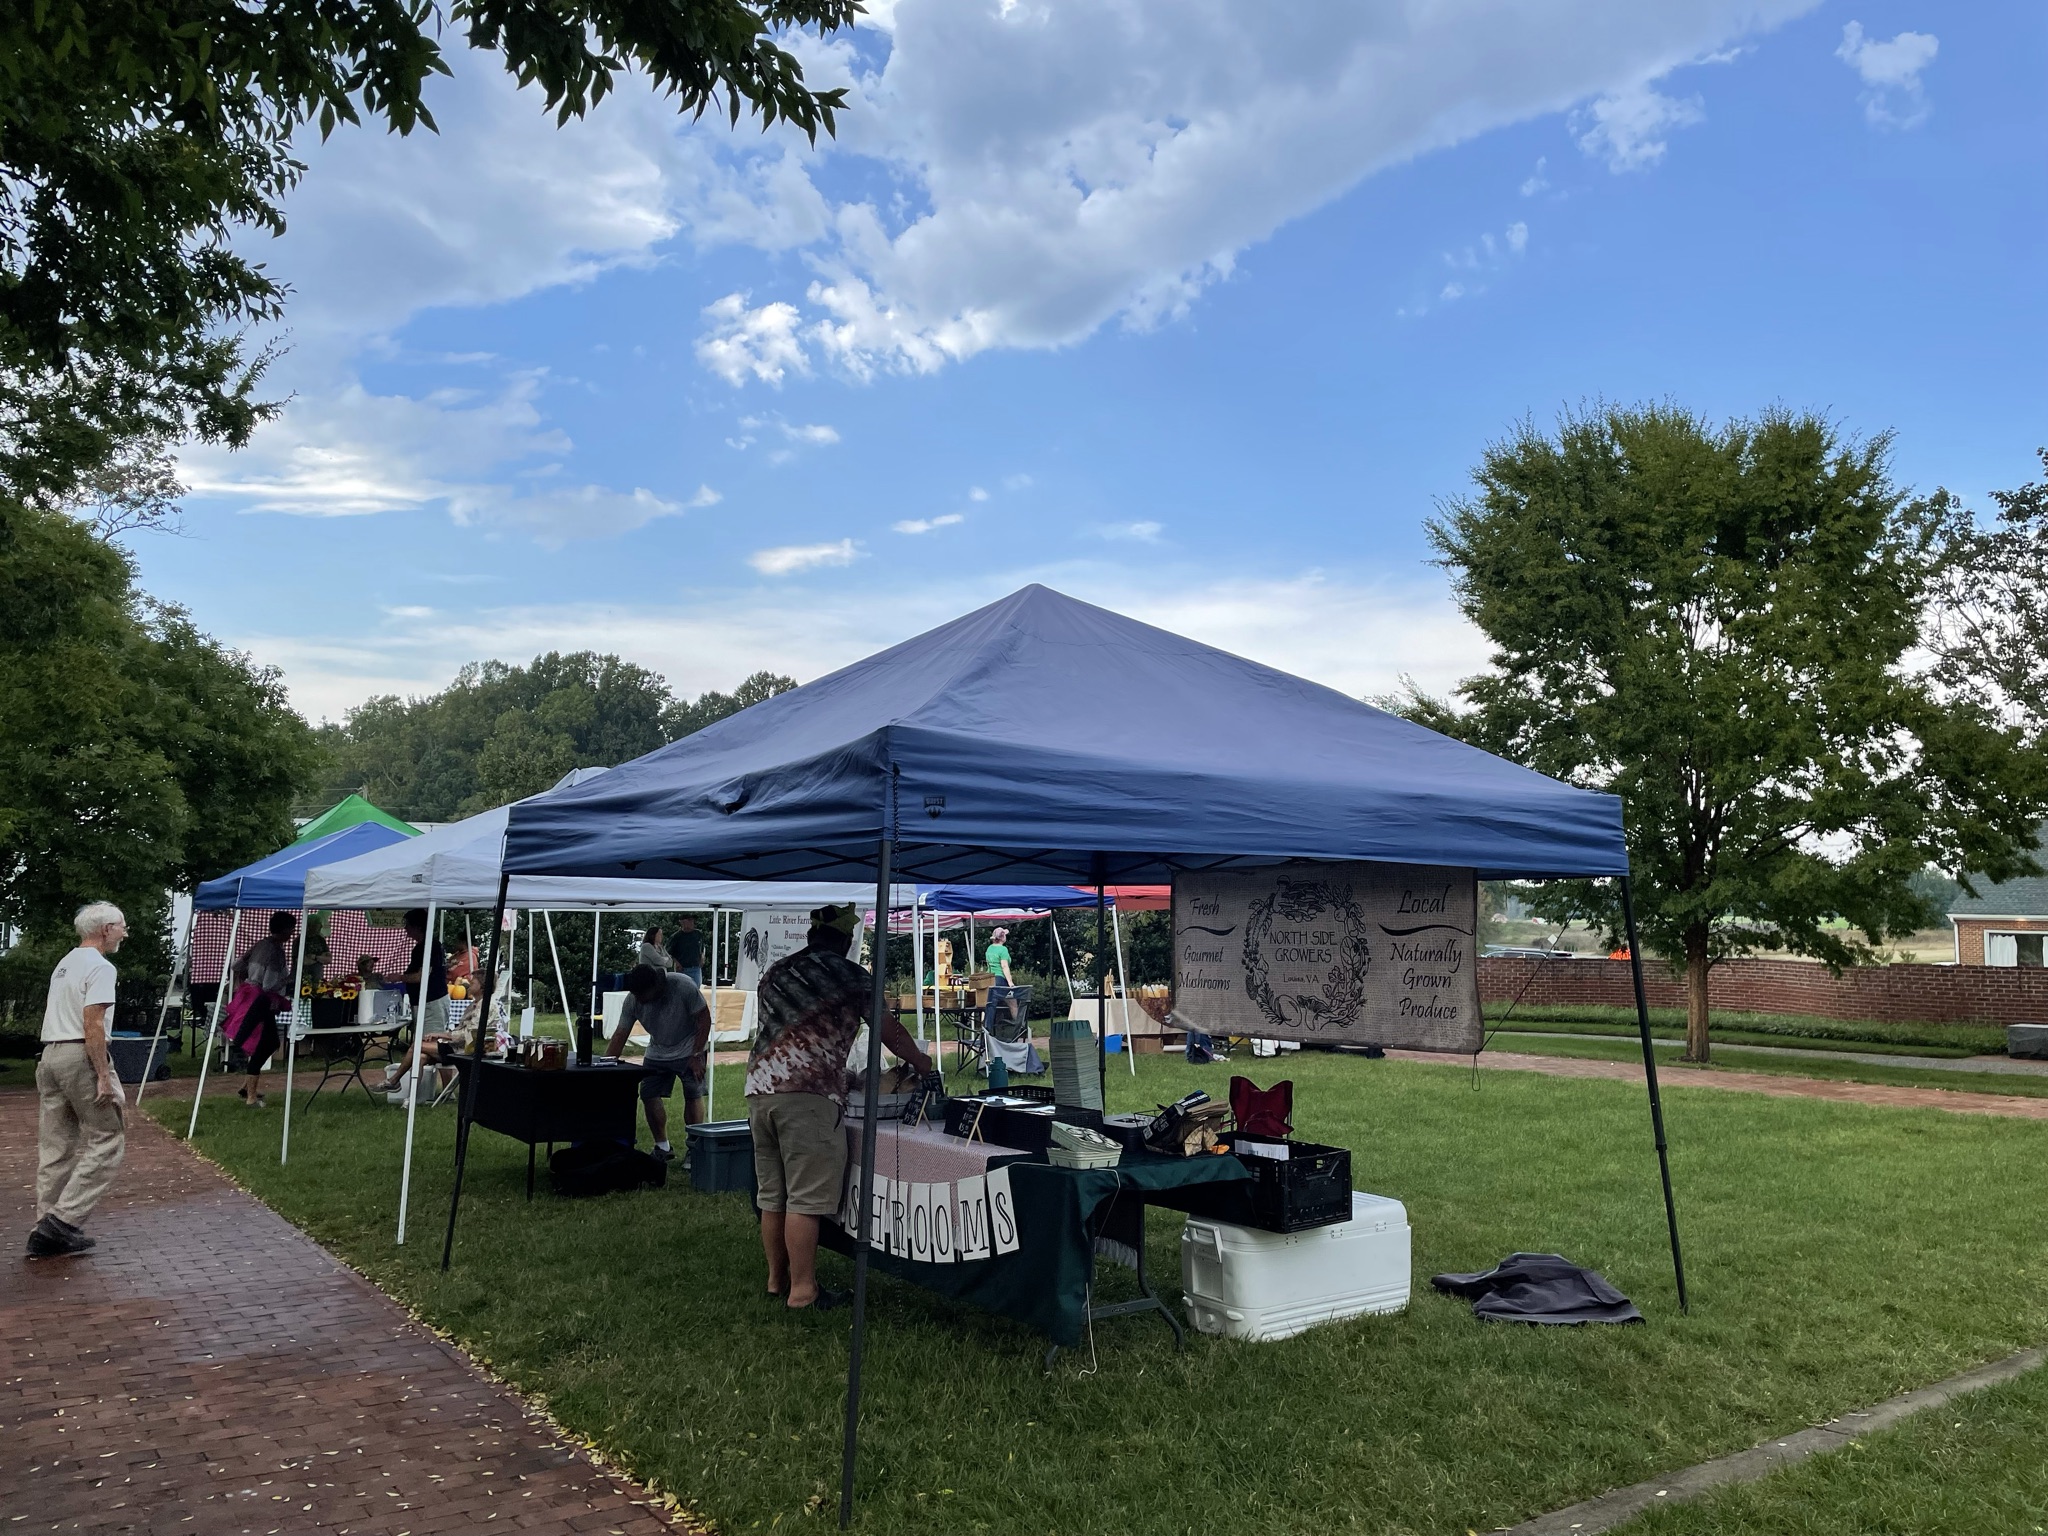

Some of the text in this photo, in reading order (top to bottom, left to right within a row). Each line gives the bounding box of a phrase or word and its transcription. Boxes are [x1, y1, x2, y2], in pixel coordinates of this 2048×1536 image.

[1190, 894, 1220, 916] Fresh
[1397, 884, 1453, 914] Local
[1269, 930, 1338, 946] NORTH SIDE
[1184, 945, 1224, 964] Gourmet
[1275, 947, 1332, 963] GROWERS
[1390, 939, 1462, 973] Naturally
[1178, 969, 1231, 990] Mushrooms
[1403, 967, 1452, 990] Grown
[1400, 995, 1457, 1019] Produce
[848, 1184, 1015, 1256] SHROOMS
